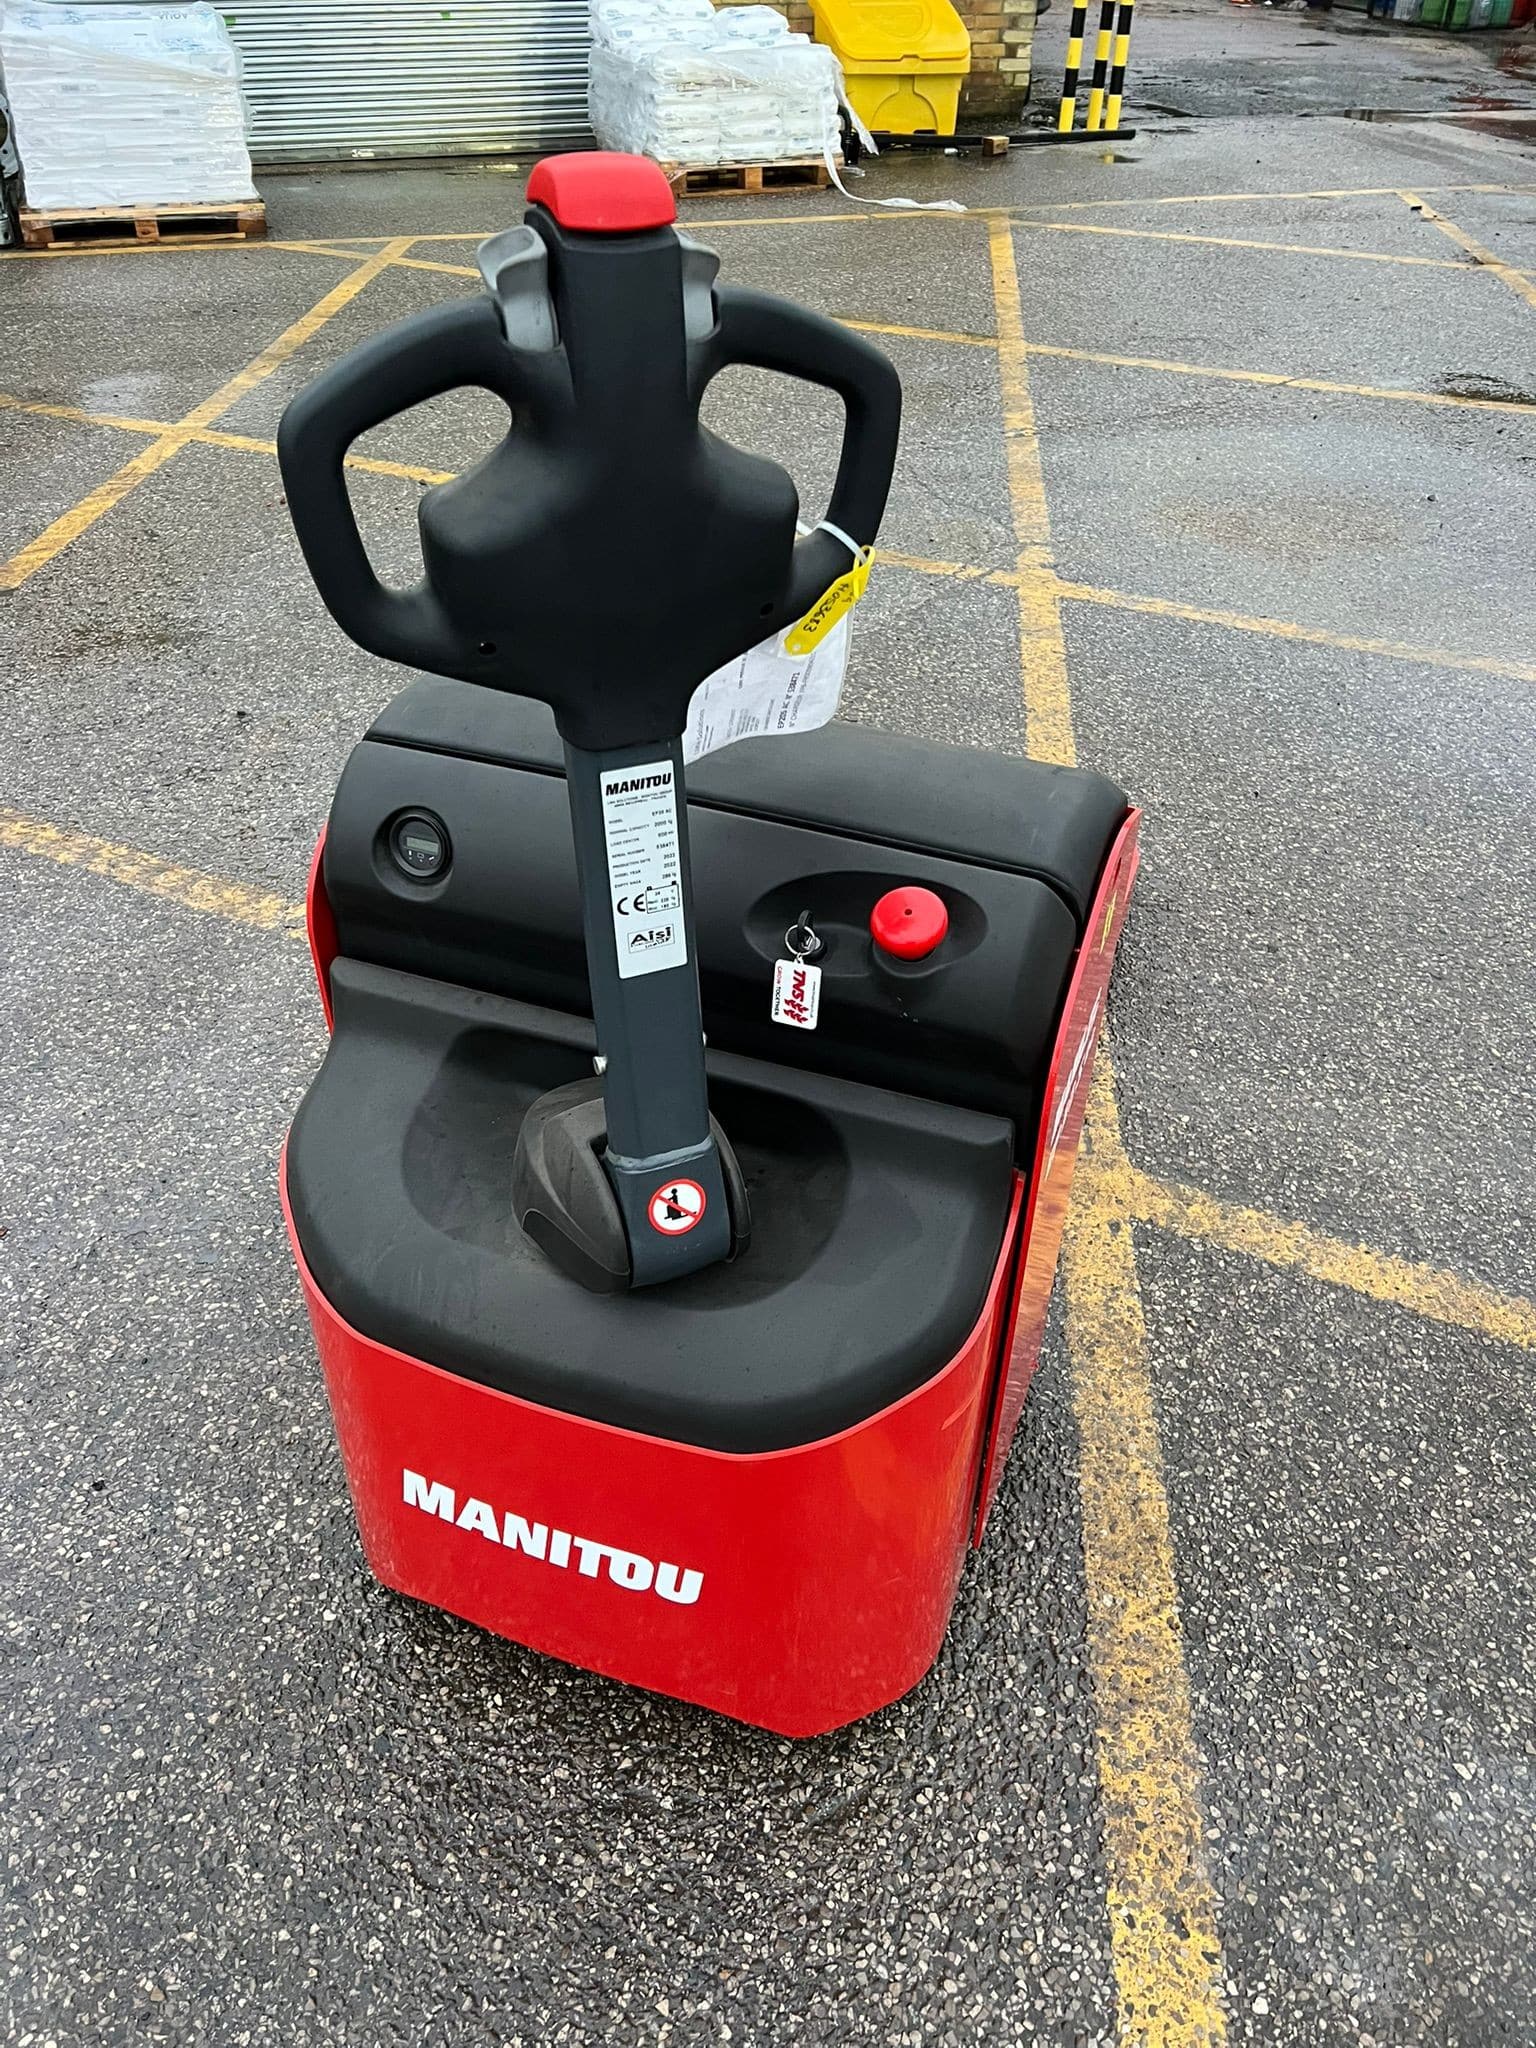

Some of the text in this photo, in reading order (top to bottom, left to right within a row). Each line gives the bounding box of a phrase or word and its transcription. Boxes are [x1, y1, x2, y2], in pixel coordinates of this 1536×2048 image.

[605, 772, 672, 796] MANITOU
[774, 986, 782, 1016] TOGETHER
[791, 969, 807, 1003] TNS
[403, 1468, 705, 1605] MANITOU
